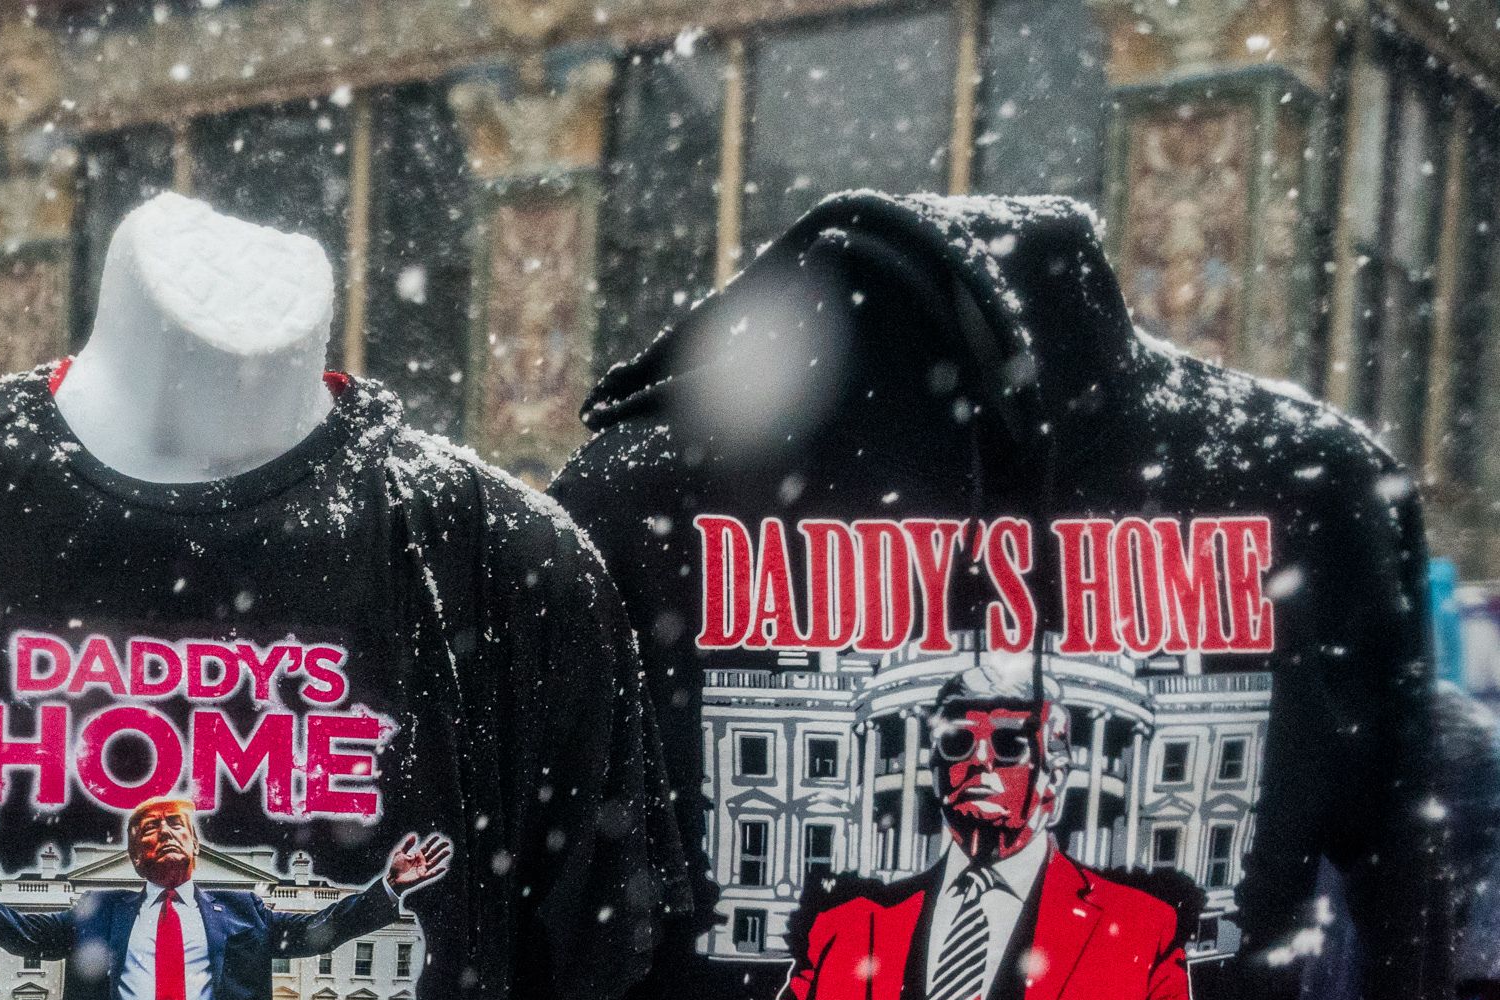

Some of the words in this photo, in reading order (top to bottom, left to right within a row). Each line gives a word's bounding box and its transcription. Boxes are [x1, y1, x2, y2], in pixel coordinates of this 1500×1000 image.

[694, 514, 1037, 654] DADDY'S
[1052, 517, 1274, 654] HOME
[11, 632, 348, 706] DADDY'S
